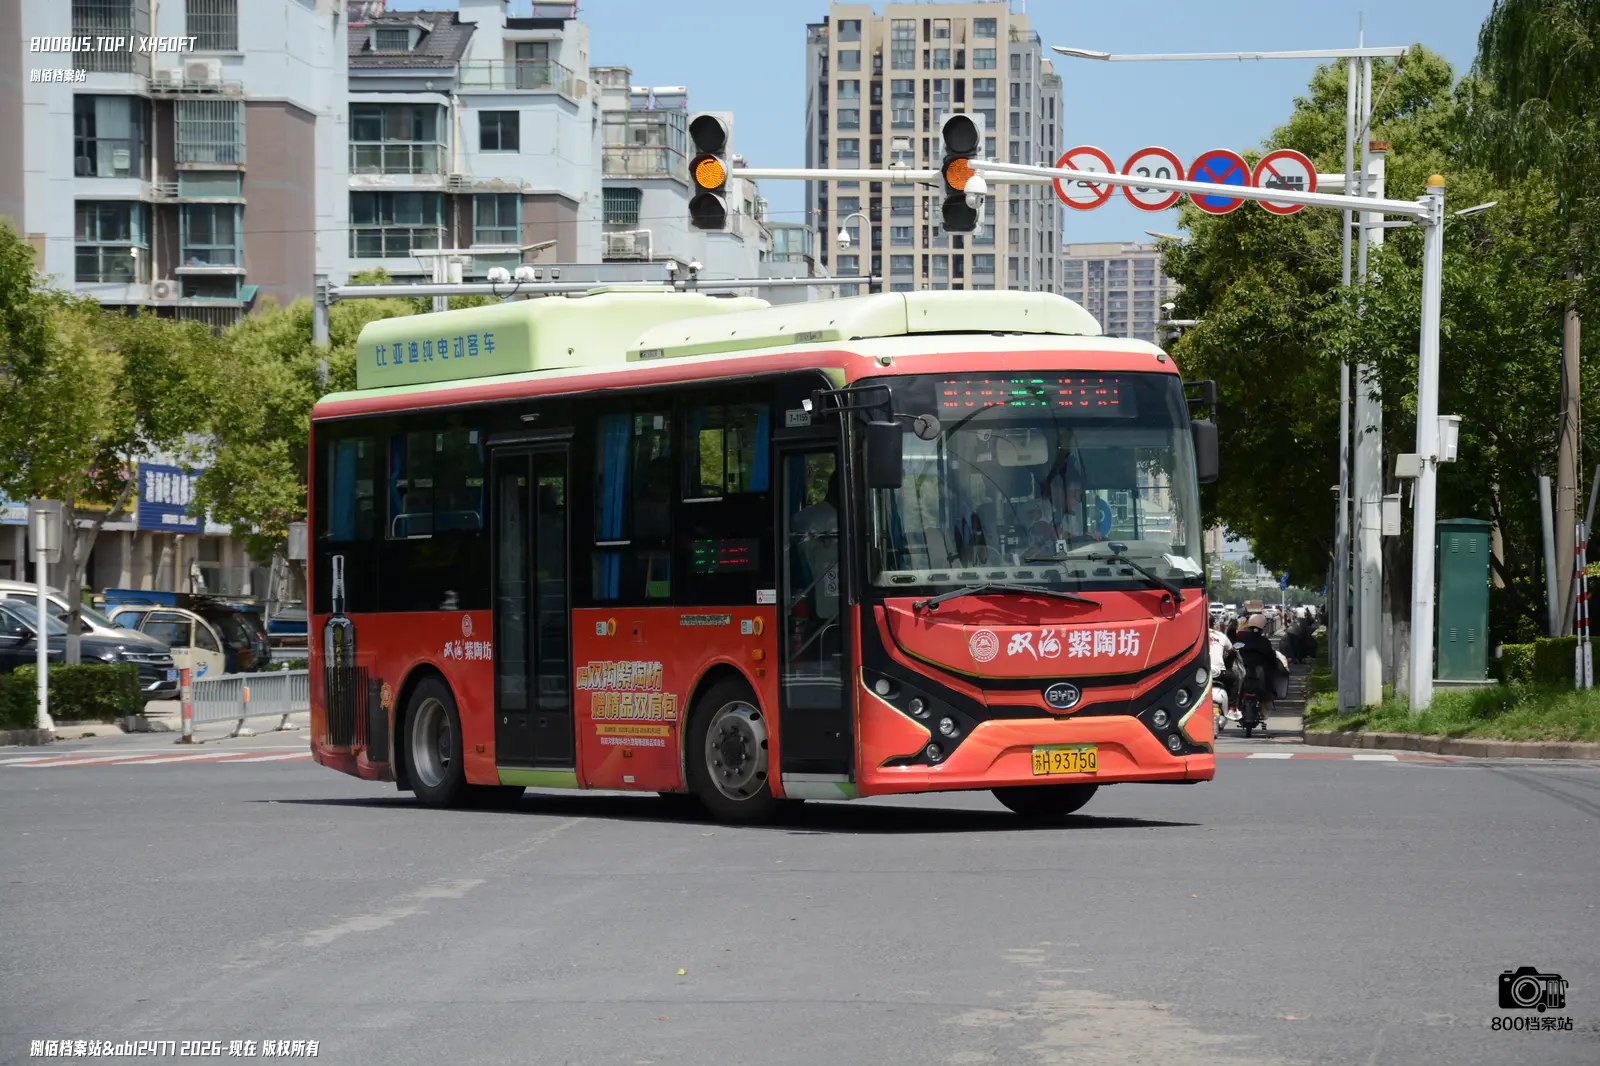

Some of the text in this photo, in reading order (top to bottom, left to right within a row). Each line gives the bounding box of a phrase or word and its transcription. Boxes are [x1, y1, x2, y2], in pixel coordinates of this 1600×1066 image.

[1136, 166, 1171, 193] 30
[375, 332, 496, 367] 比亚迪纯电动客车
[592, 691, 678, 720] 赠精品双肩包
[1049, 690, 1076, 702] BYD
